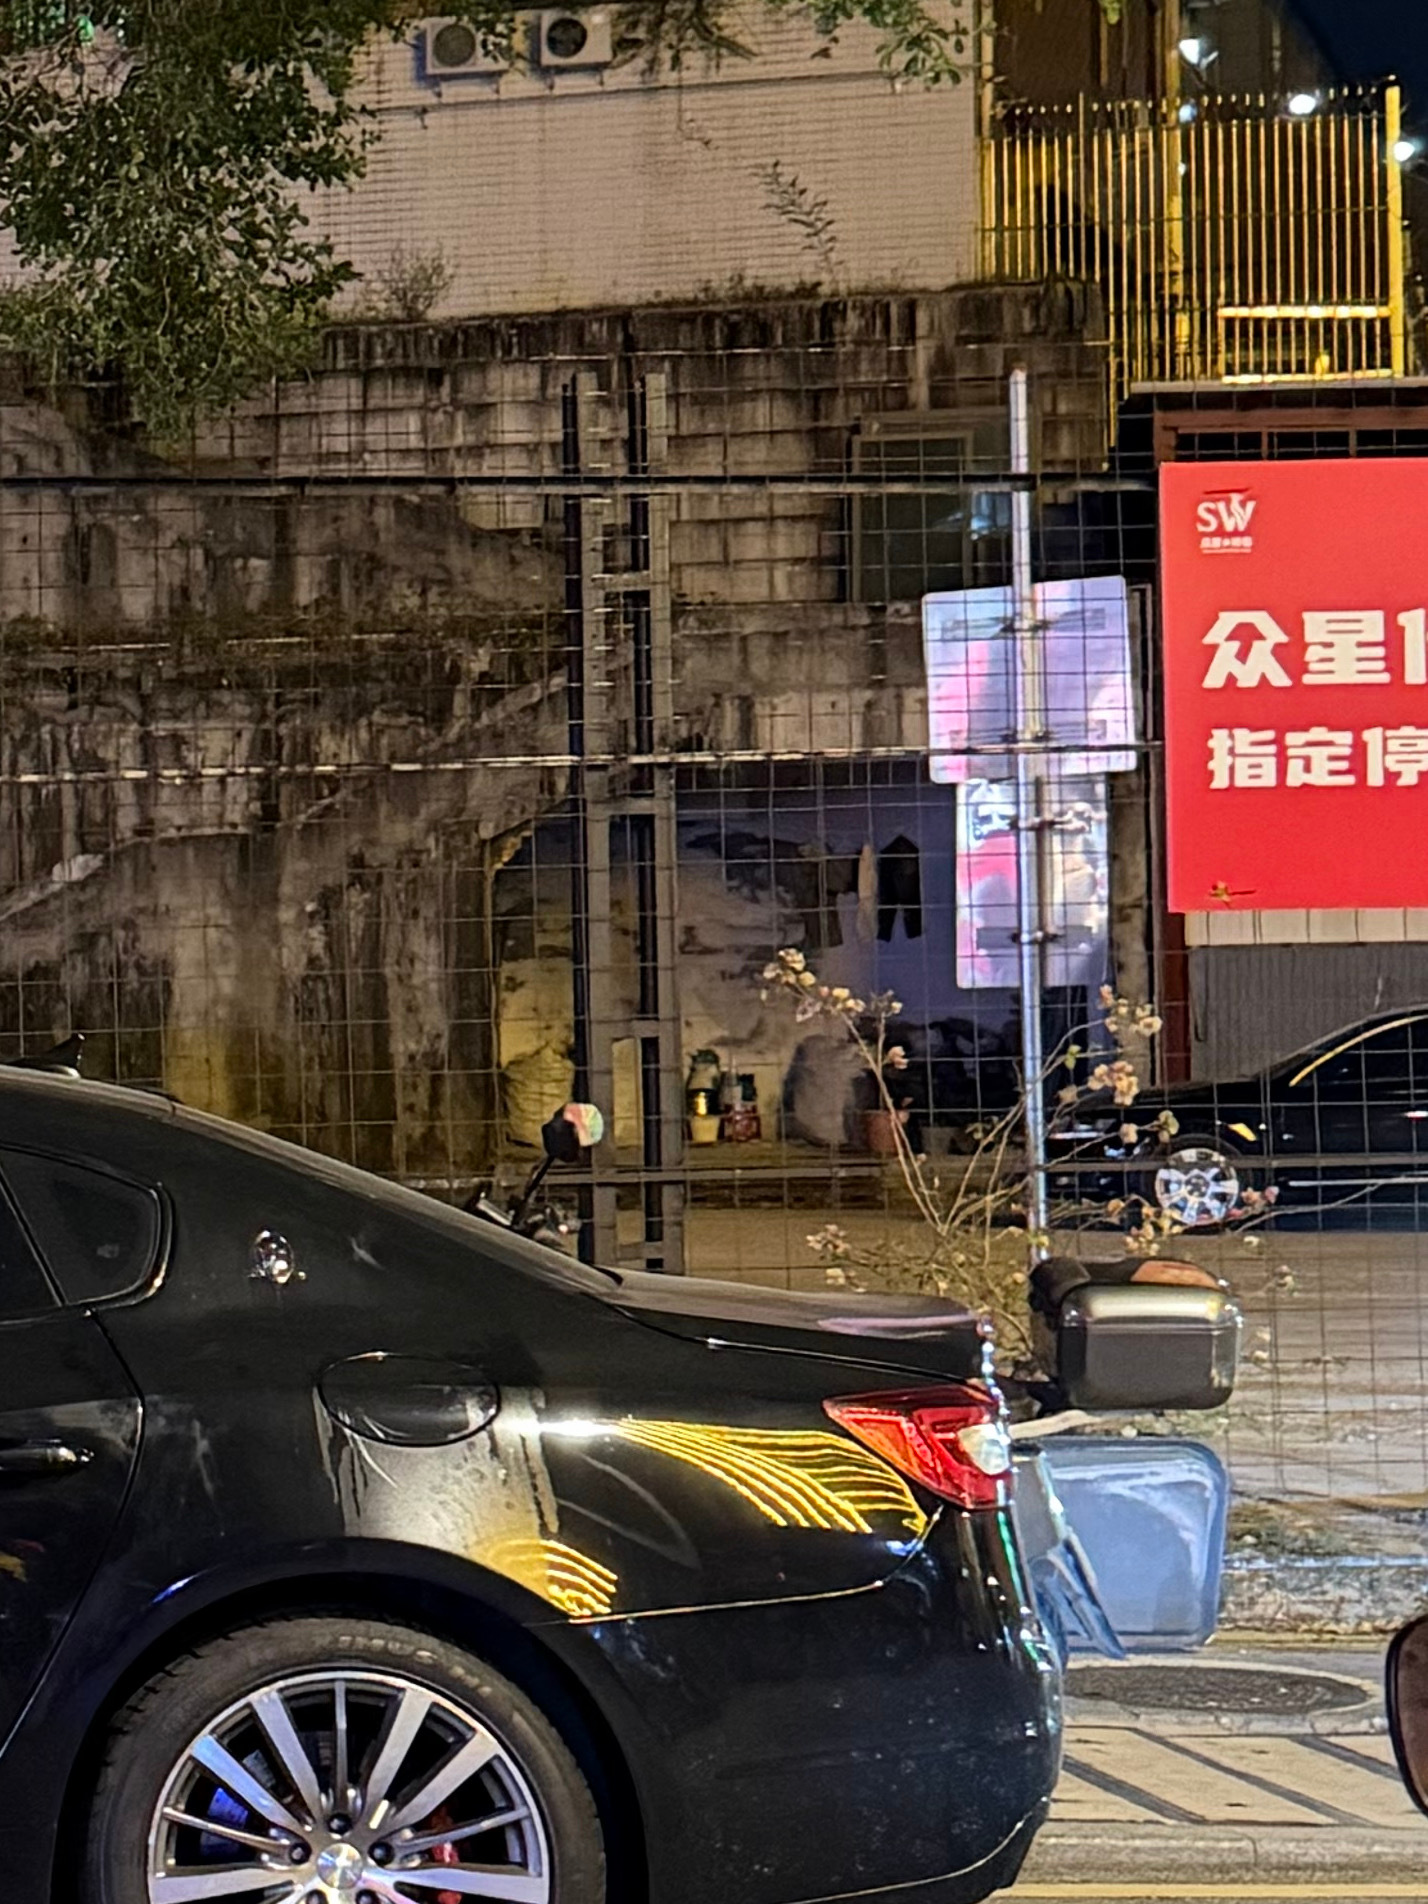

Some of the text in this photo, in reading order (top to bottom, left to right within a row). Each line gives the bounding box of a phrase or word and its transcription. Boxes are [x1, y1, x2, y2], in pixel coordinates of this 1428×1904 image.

[1196, 493, 1257, 533] SW
[1207, 726, 1428, 790] 指定停
